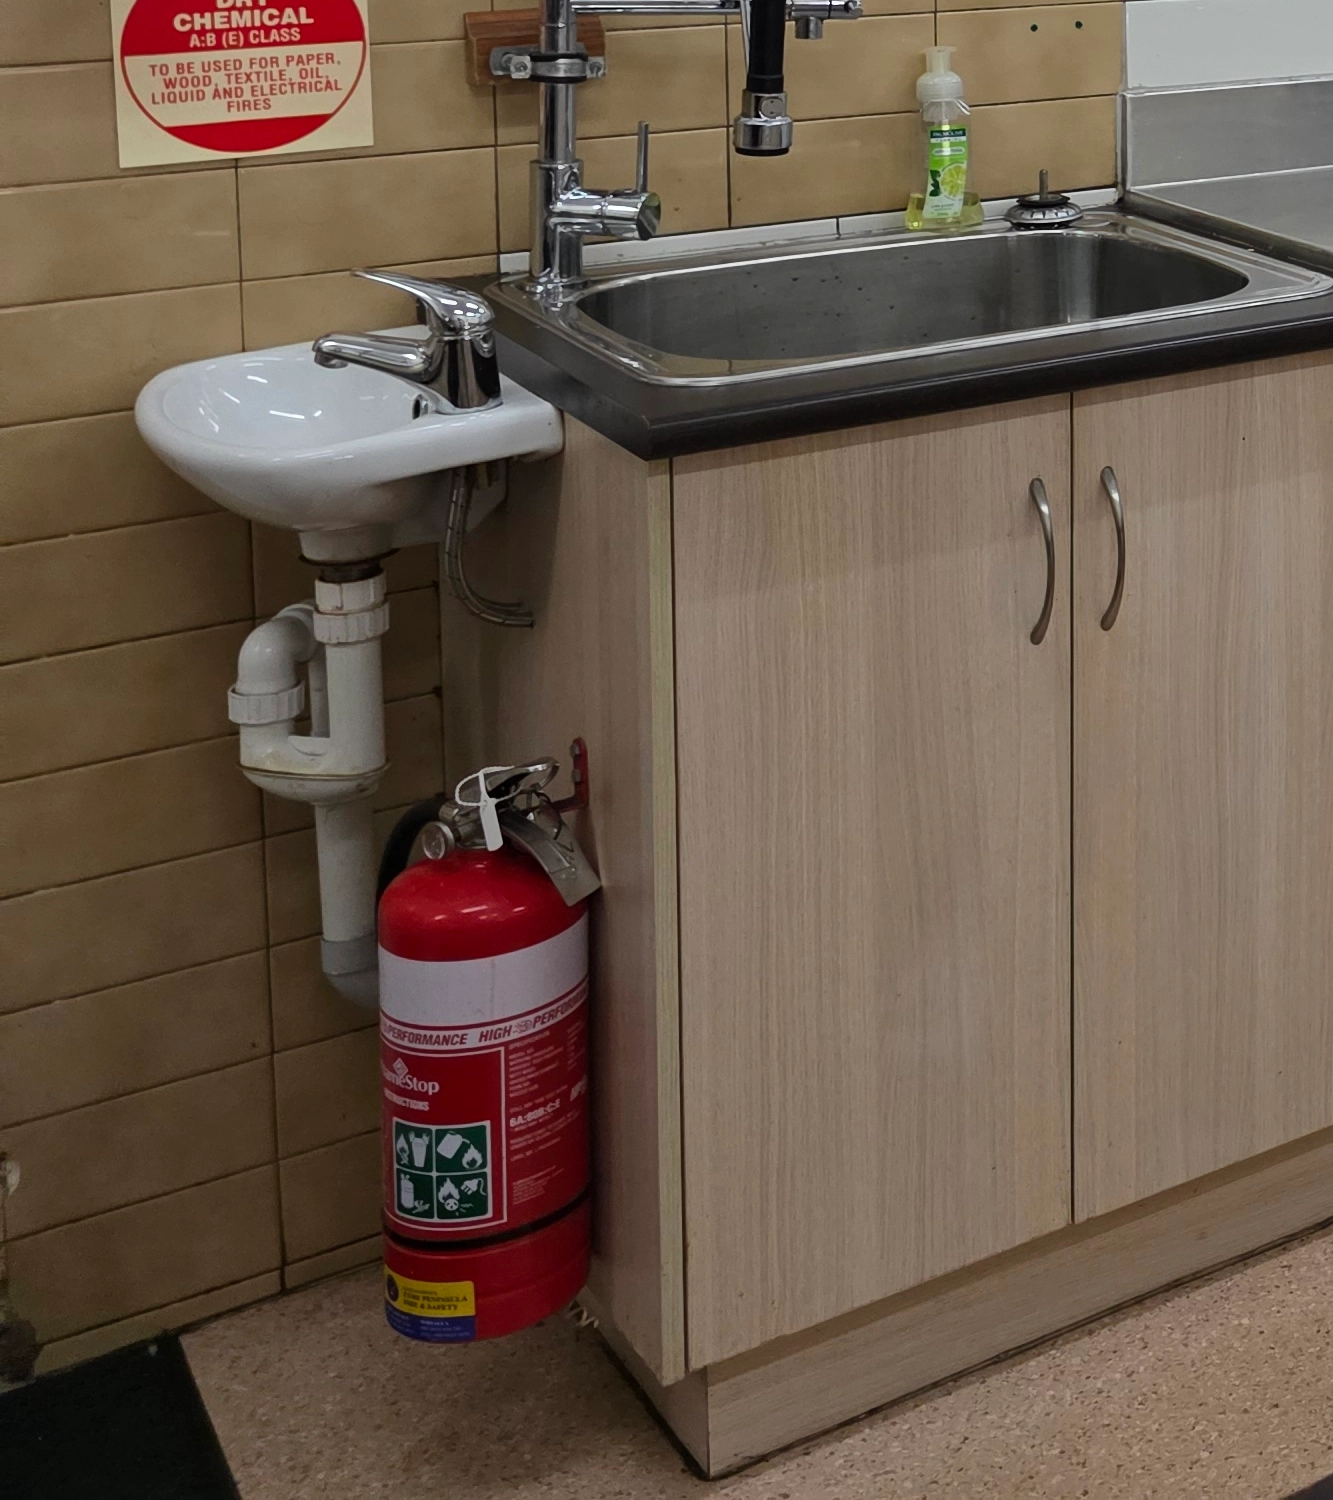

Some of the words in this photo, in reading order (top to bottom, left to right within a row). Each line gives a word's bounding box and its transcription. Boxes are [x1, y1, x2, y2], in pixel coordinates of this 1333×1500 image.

[173, 7, 314, 32] CHEMICAL
[222, 31, 244, 47] (E)
[249, 28, 301, 44] CLASS
[148, 64, 170, 77] TO
[176, 62, 195, 75] BE
[201, 58, 243, 73] USED
[249, 56, 280, 70] FOR
[285, 53, 341, 68] PAPER,
[151, 90, 206, 105] LIQUID
[212, 86, 245, 101] AND
[250, 78, 342, 98] ELECTRICAL
[227, 98, 272, 113] FIRES
